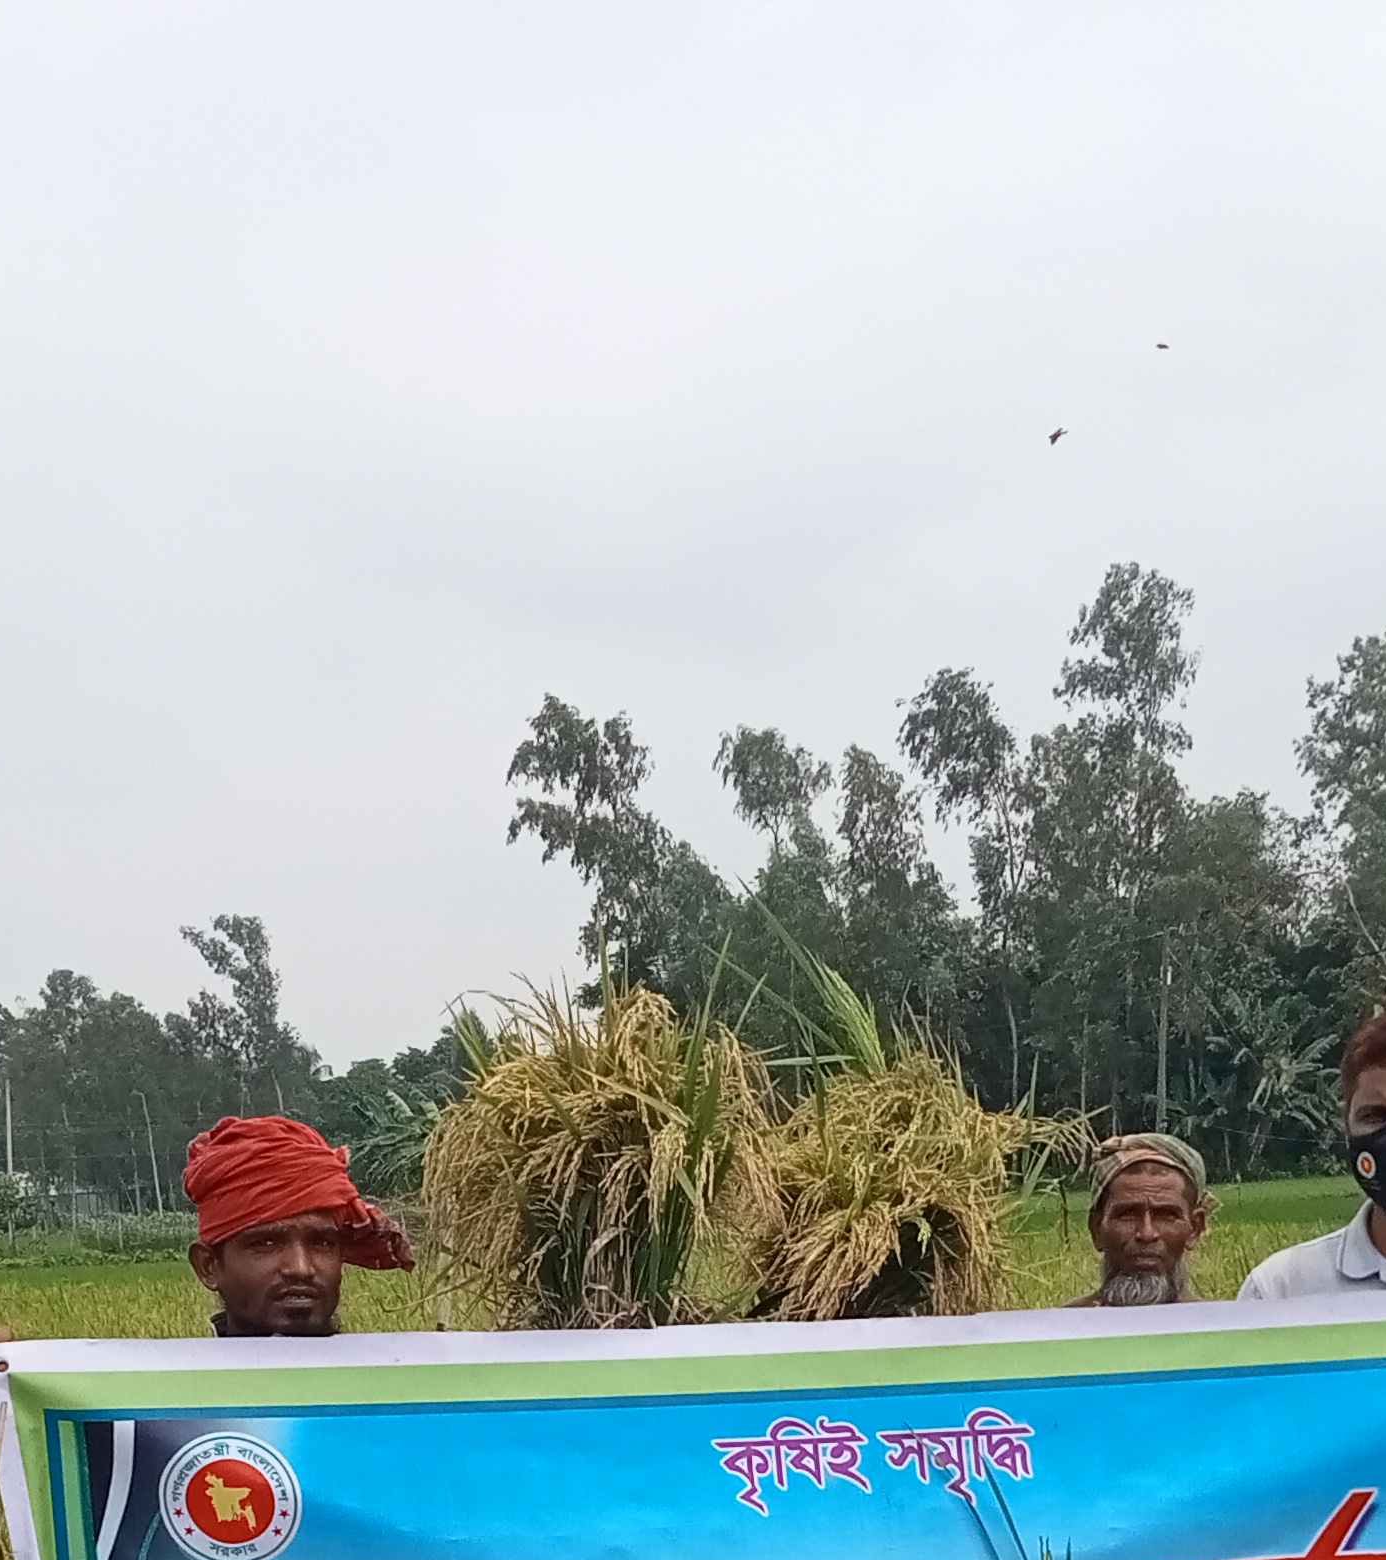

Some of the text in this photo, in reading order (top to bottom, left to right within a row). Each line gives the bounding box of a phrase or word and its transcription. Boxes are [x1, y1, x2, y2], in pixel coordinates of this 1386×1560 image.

[236, 1446, 289, 1502] বাংলাদেশ
[711, 1406, 1035, 1517] কৃষিই সমৃদ্ধি
[210, 1542, 258, 1557] সরকার
